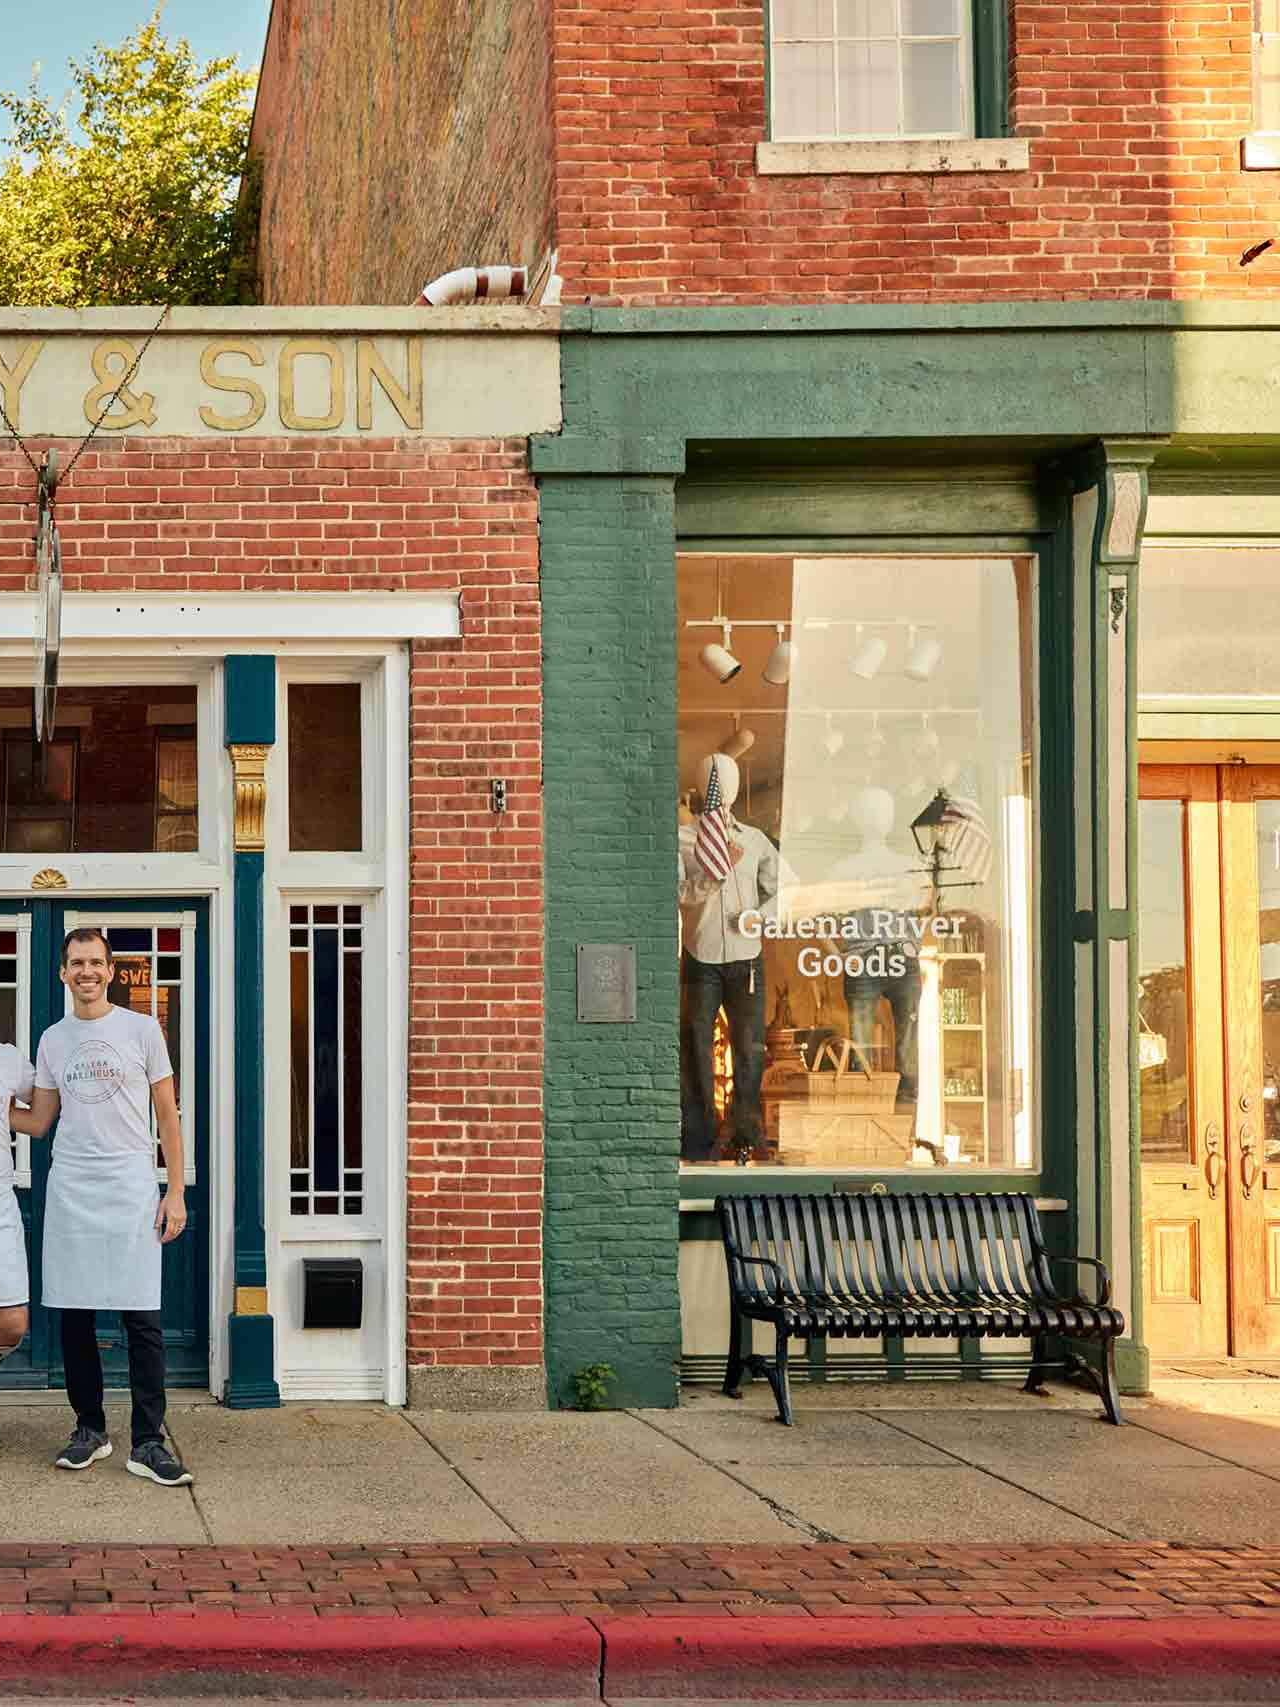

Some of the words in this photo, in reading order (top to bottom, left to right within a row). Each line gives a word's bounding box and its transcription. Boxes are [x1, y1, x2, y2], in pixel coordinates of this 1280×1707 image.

[82, 338, 158, 431] &
[199, 339, 423, 431] SON
[738, 910, 860, 940] Galena
[871, 909, 966, 939] River
[797, 946, 907, 977] Goods
